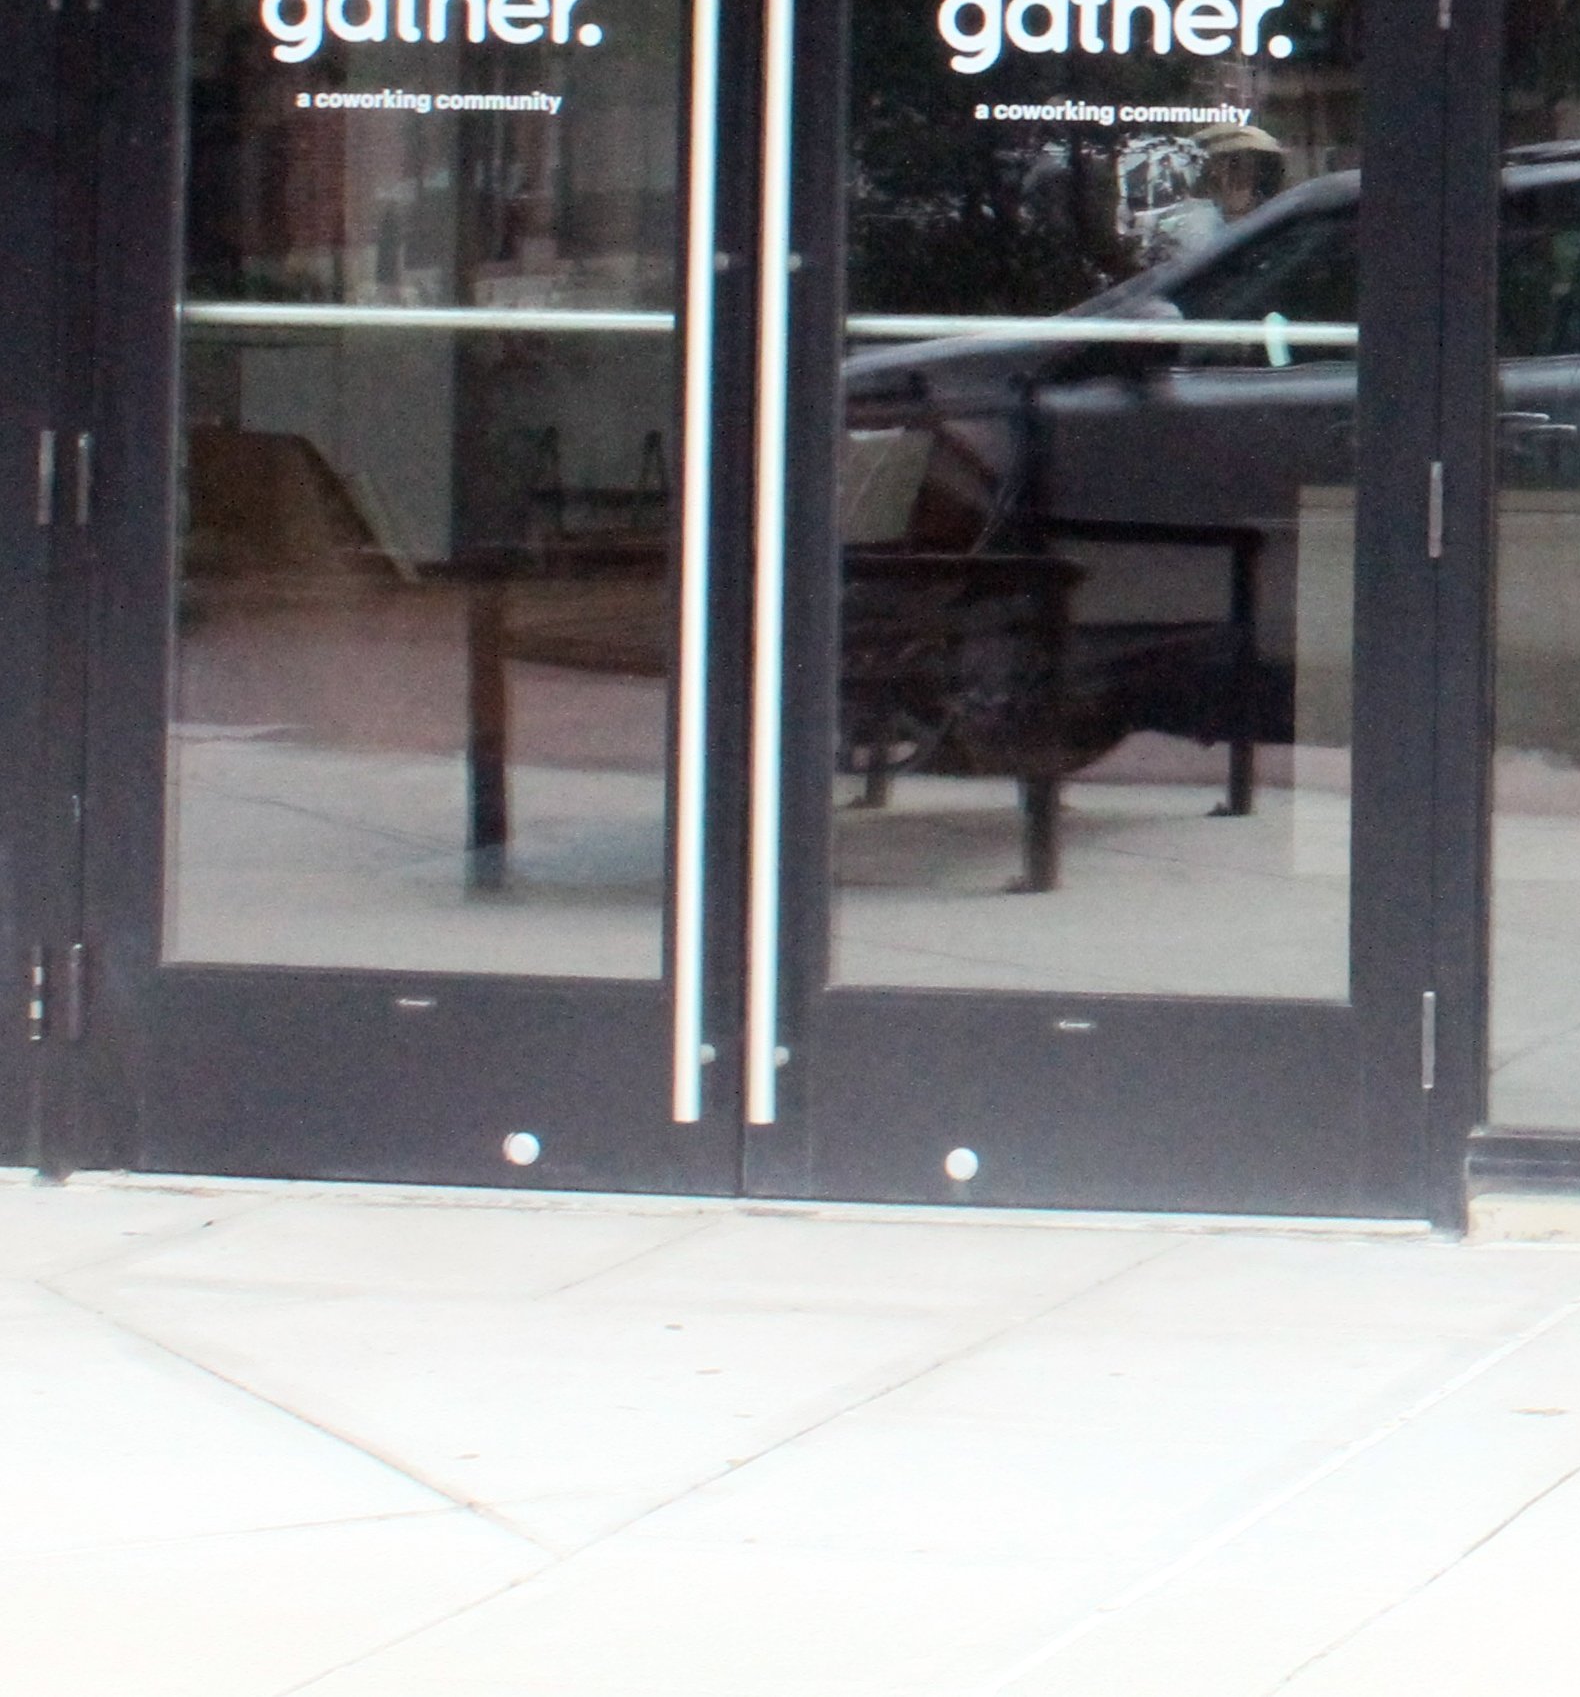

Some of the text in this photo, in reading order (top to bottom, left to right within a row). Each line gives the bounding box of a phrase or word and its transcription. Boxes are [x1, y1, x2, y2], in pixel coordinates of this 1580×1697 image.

[296, 89, 562, 115] a coworking community
[975, 100, 1251, 127] a coworking community
